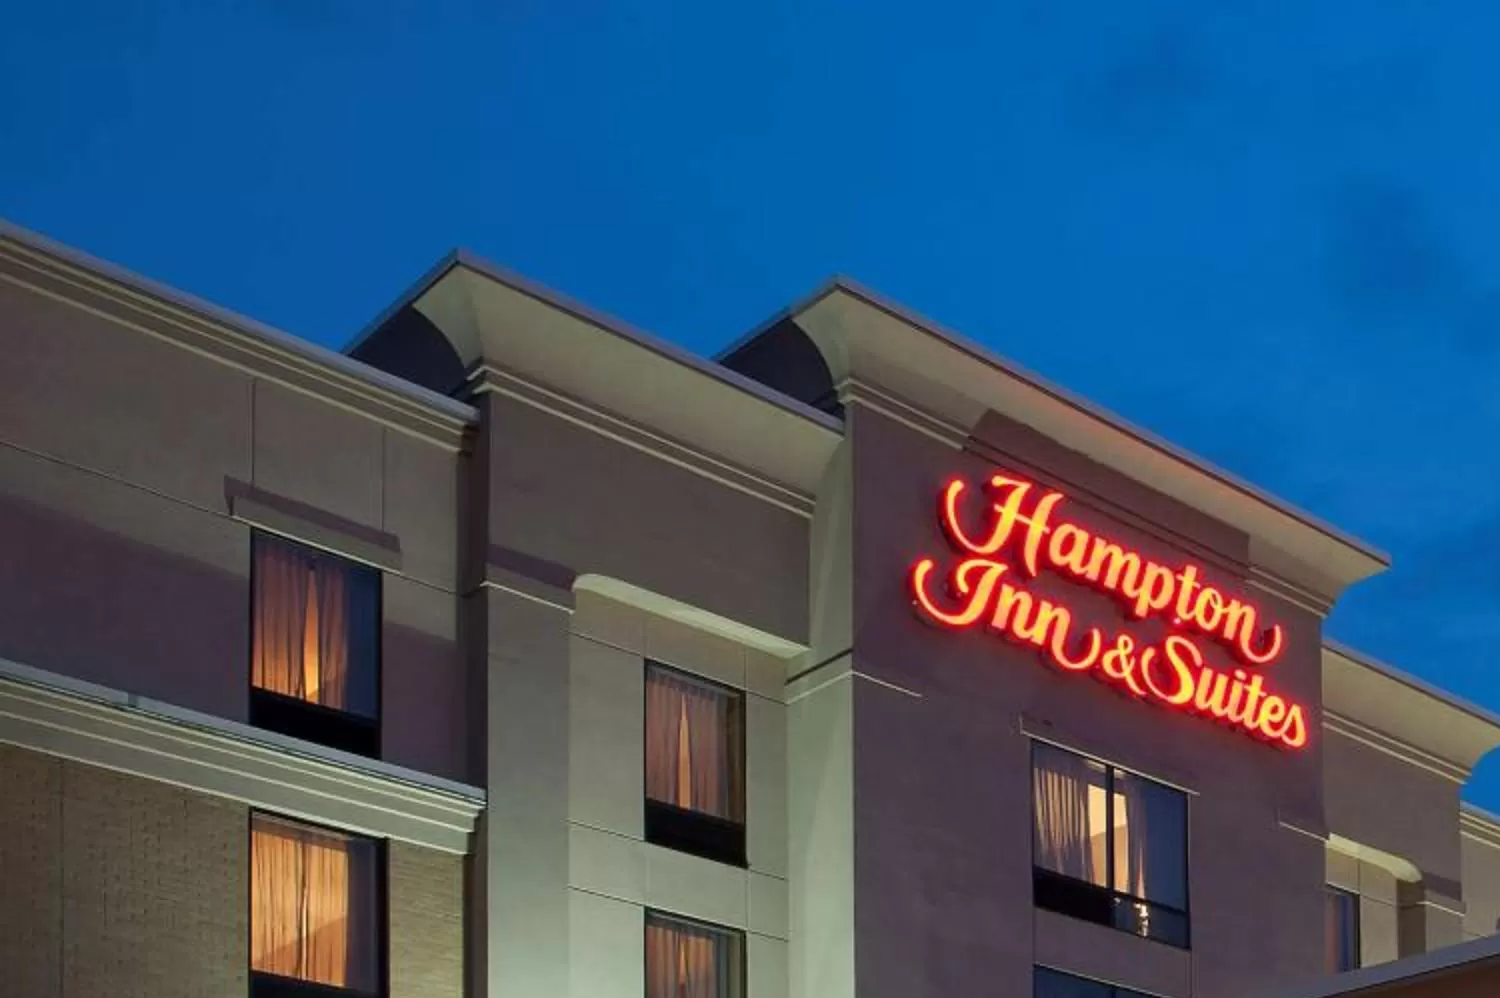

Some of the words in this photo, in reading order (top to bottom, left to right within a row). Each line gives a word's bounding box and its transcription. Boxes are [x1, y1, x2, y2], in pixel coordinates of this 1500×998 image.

[913, 558, 1099, 669] Inn
[1103, 634, 1147, 696] &
[1140, 634, 1306, 748] Suites
[944, 475, 1281, 663] Hampton
